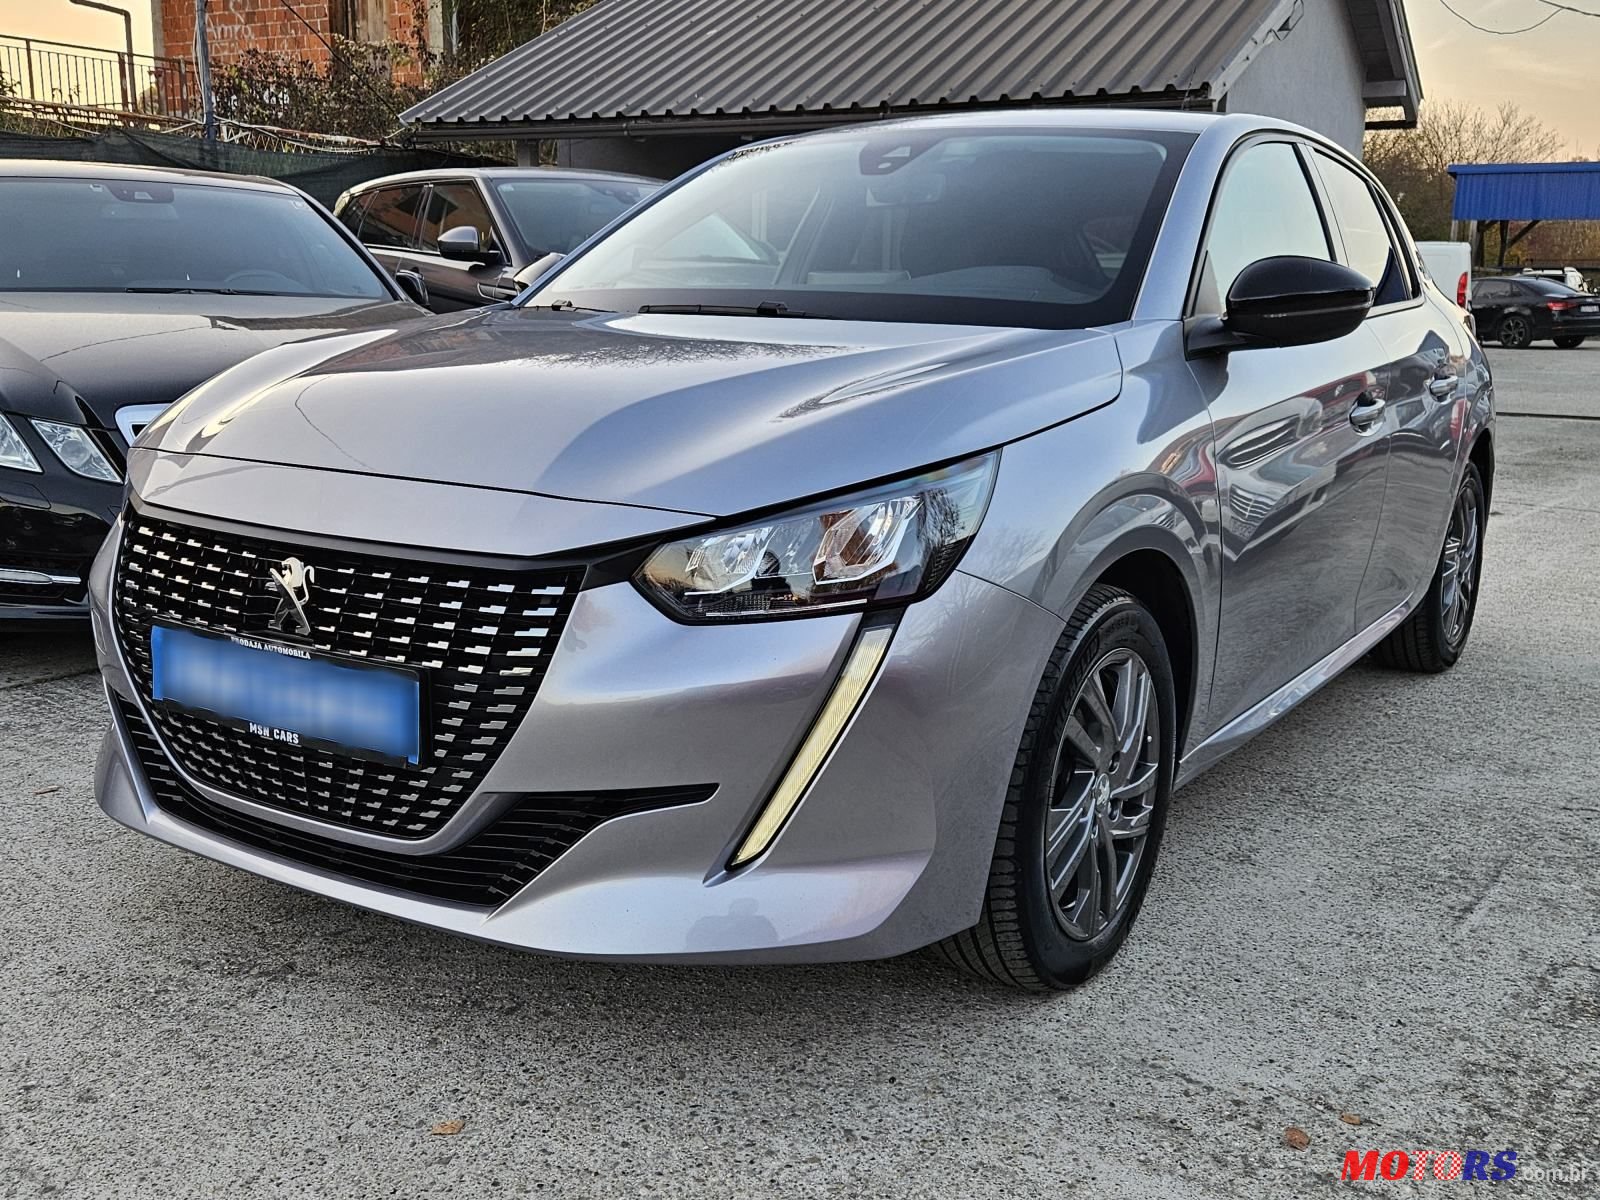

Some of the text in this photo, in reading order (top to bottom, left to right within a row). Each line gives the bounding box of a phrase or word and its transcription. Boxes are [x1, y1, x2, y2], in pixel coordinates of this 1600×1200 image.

[263, 643, 311, 659] AUTOMOBILA
[249, 722, 299, 744] MSN CARS
